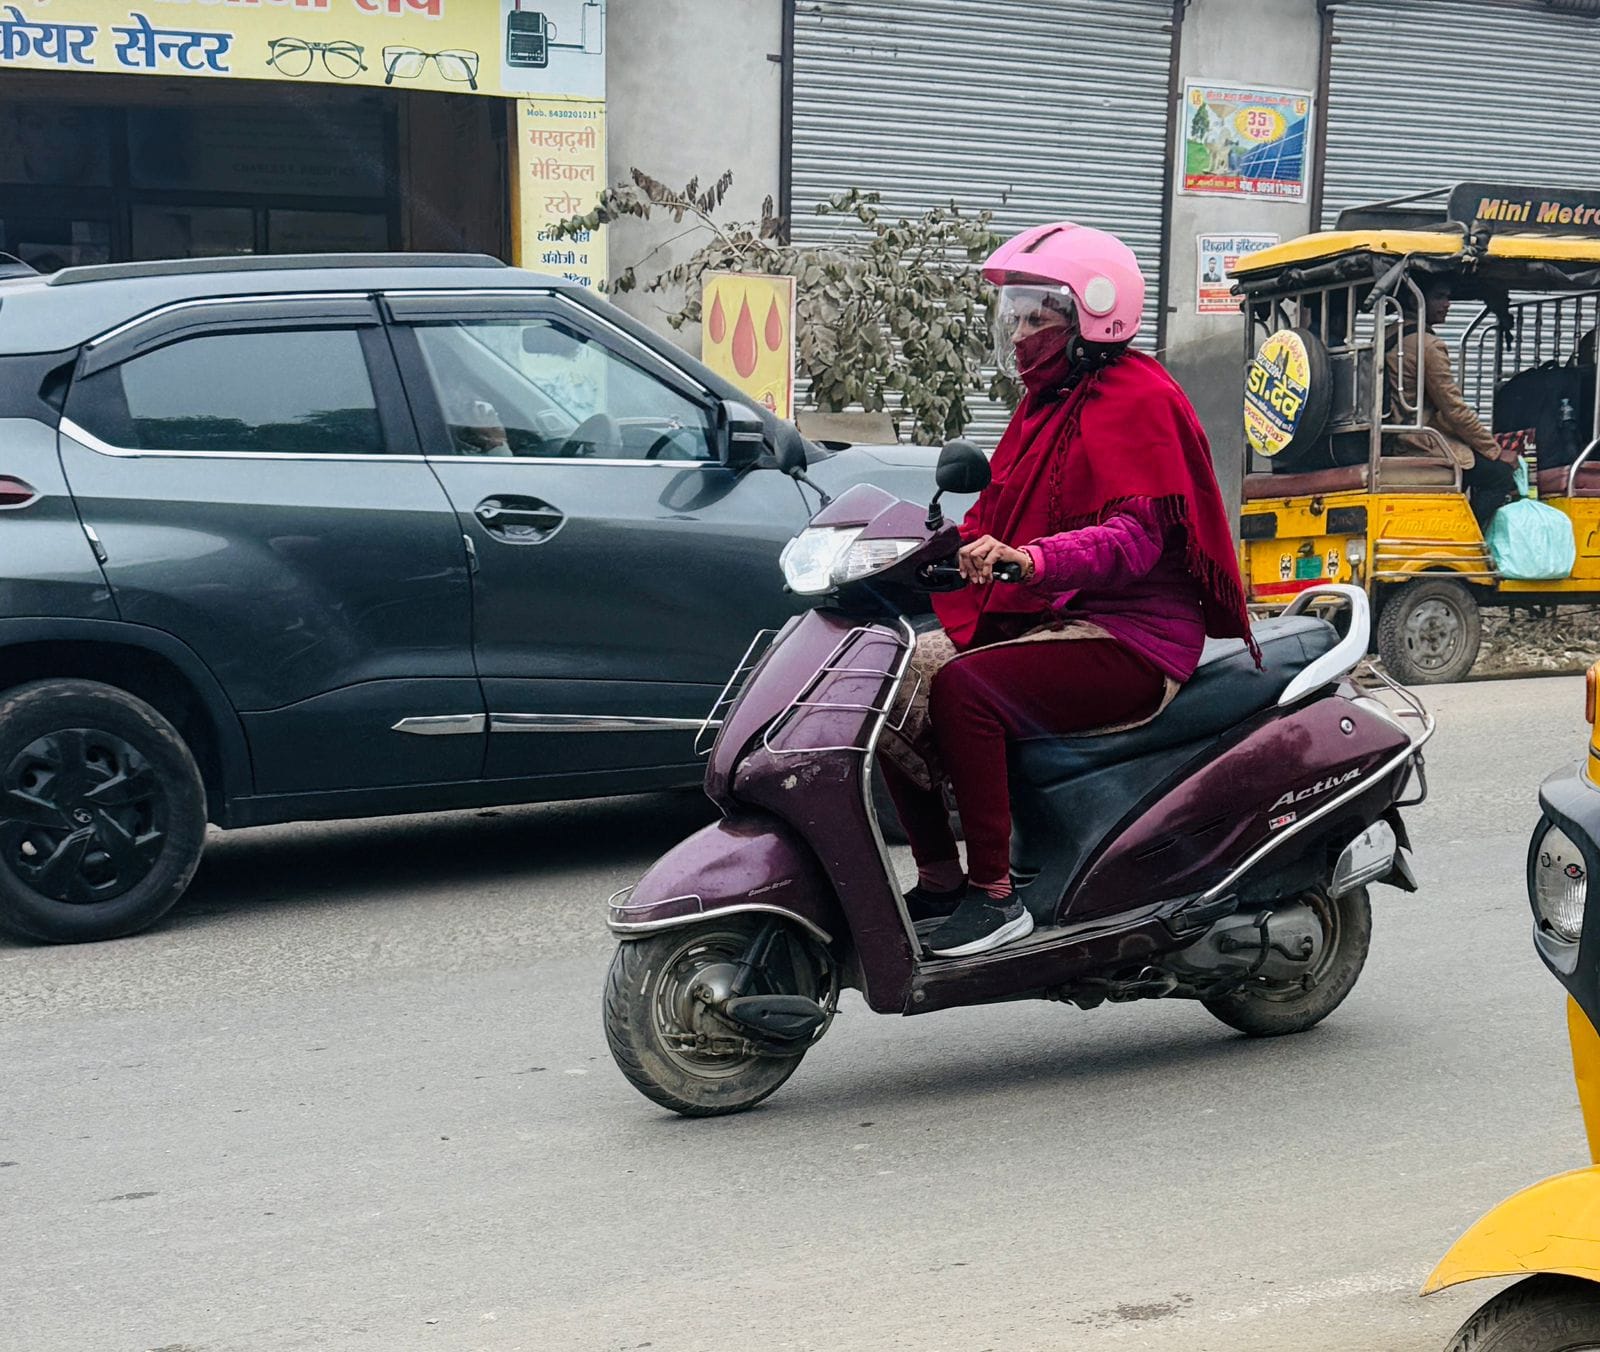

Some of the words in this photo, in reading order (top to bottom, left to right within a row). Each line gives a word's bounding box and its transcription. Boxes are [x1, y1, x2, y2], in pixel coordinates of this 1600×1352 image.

[112, 13, 233, 72] सेन्टर
[530, 157, 595, 182] मेडिकल
[544, 190, 582, 214] स्टोर
[1475, 198, 1532, 222] Mini
[1267, 767, 1361, 812] Activa
